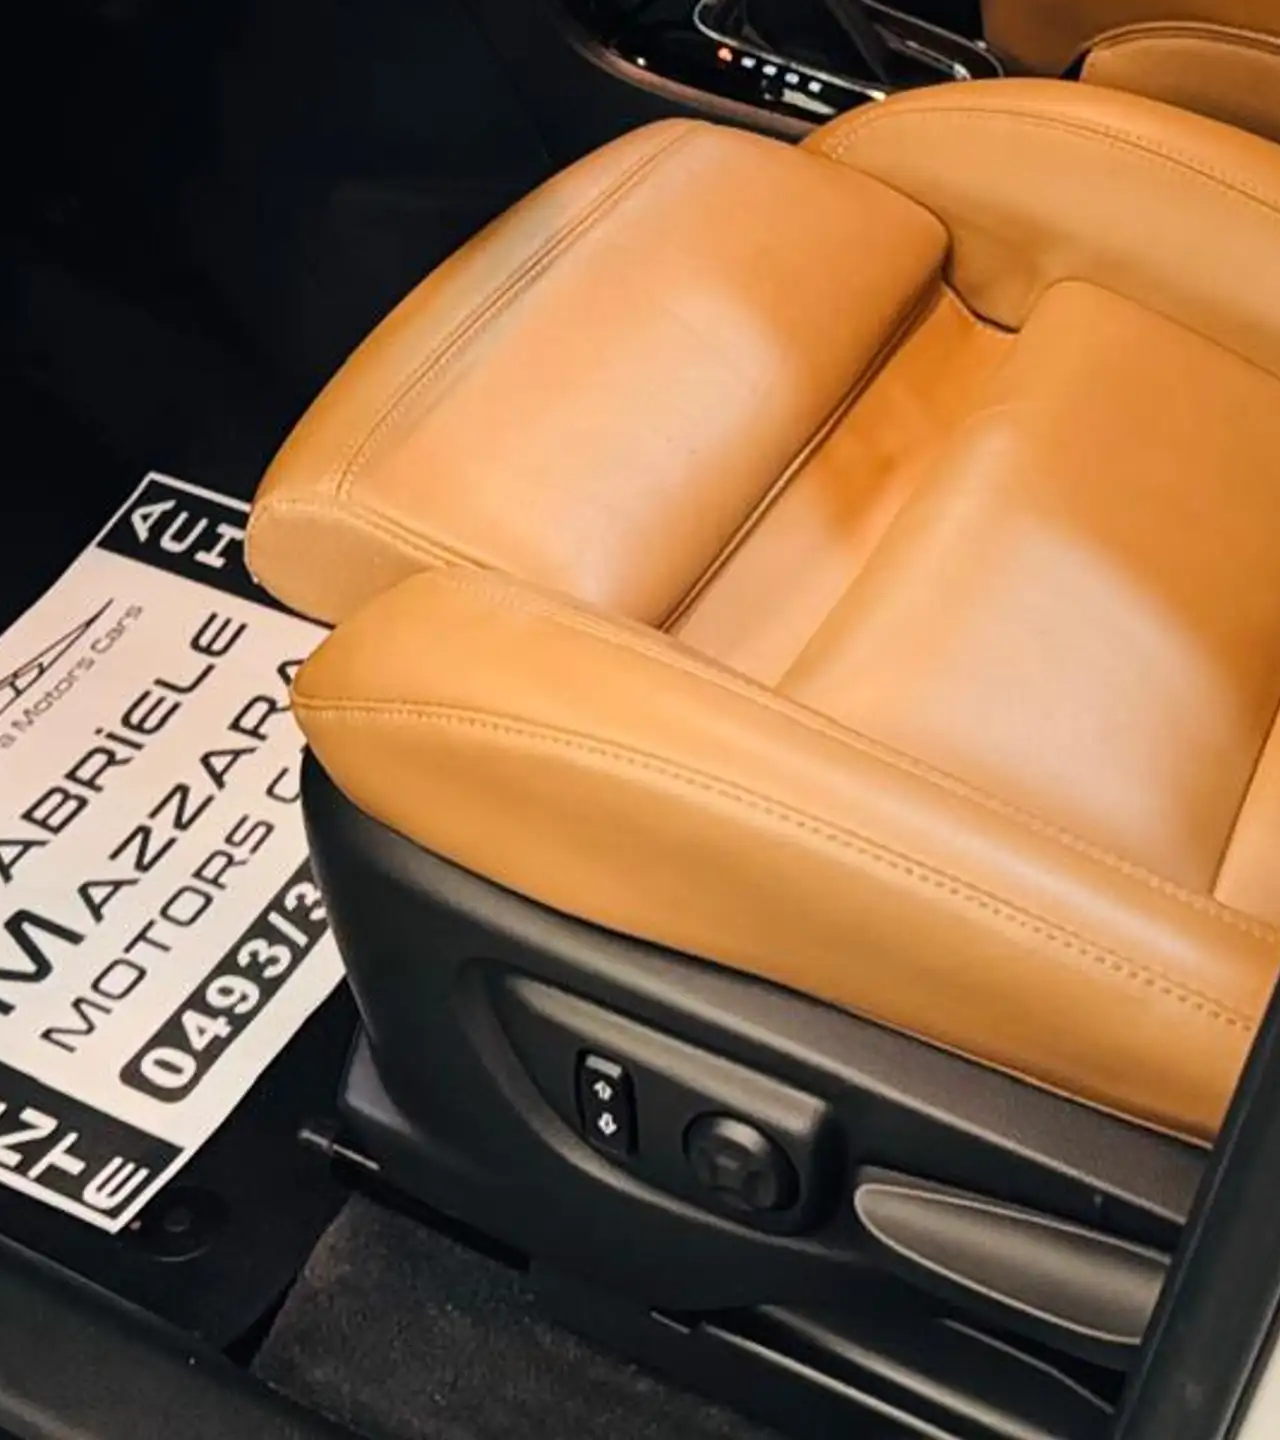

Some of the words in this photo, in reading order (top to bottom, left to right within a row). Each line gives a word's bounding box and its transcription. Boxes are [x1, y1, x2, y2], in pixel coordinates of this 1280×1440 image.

[11, 656, 96, 733] Motors
[90, 604, 144, 655] Cars
[39, 813, 276, 1055] MOTORS
[140, 880, 328, 1089] 0493/3
